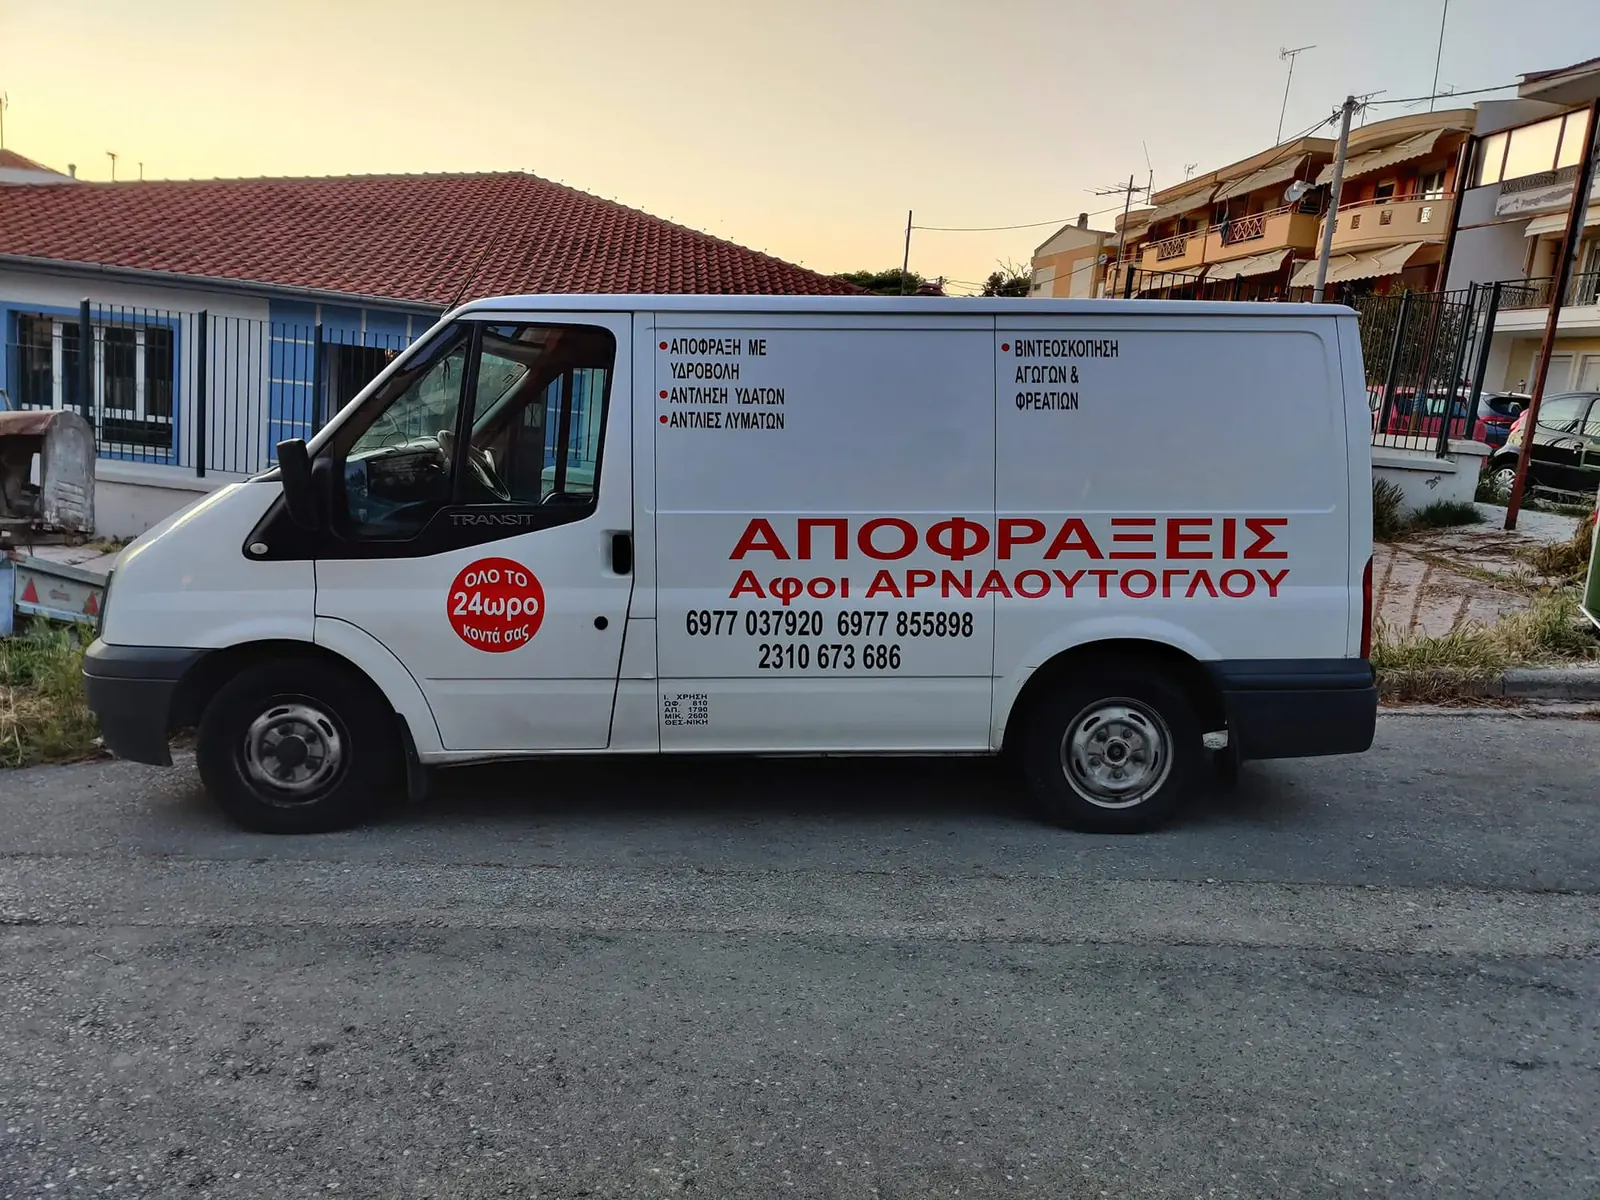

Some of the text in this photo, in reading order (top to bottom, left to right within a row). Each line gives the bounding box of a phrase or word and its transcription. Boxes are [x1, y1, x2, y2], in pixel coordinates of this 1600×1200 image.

[670, 338, 767, 356] ΑΠΟΦΡΑΞΗ ΜΕ
[1015, 339, 1119, 358] ΒΙΝΤΕΟΣΚΟΠΗΣΗ
[670, 362, 740, 380] ΥΔΡΟΒΟΛΗ
[1015, 365, 1079, 384] ΑΓΩΓΩΝ &
[669, 387, 785, 405] ΑΝΤΛΗΣΗ ΥΔΑΤΩΝ
[1015, 392, 1079, 411] ΦΡΕΑΤΙΩΝ
[669, 411, 785, 430] ΑΝΤΛΙΕΣ ΛΥΜΑΤΩΝ
[450, 514, 534, 526] TRANSIT
[728, 517, 1288, 561] ΑΠΟΦΡΑΞΕΙΣ
[464, 569, 528, 587] ΟΛΟ ΤΟ
[728, 569, 1290, 606] Αφοι ΑΡΝΑΟΥΤΟΓΛΟΥ
[453, 591, 539, 622] 24ωρο
[686, 609, 974, 637] 6977 037920 6977 855898
[463, 623, 529, 643] κοντά σας
[758, 643, 901, 670] 2310 673 686
